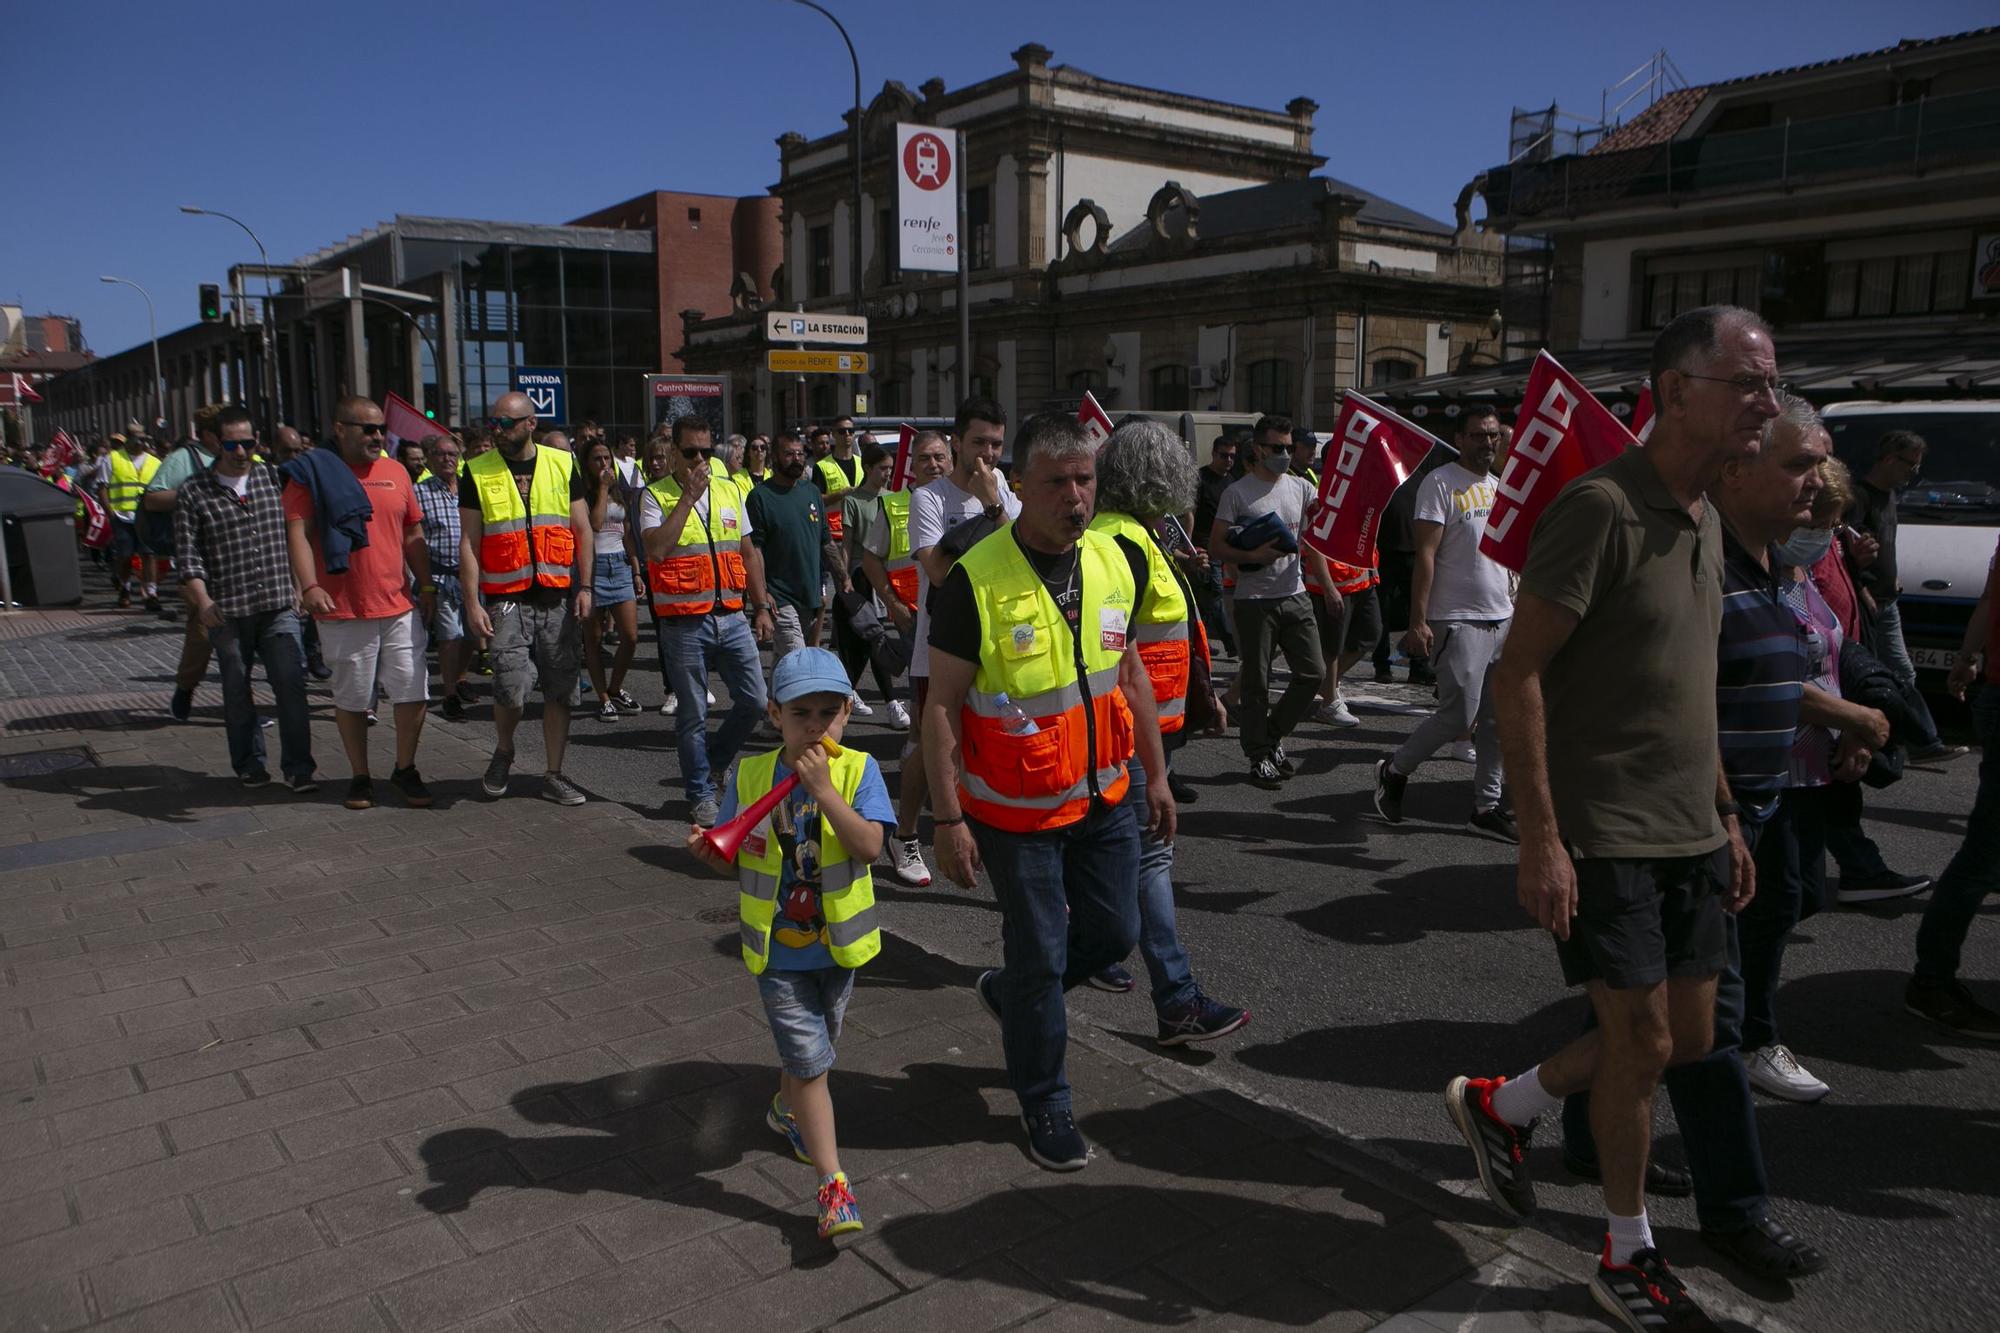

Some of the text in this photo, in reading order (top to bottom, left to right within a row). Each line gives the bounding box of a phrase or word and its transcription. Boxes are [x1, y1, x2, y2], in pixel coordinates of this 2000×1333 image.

[904, 216, 941, 233] renfe
[808, 323, 820, 334] LA
[823, 323, 865, 337] ESTACIÓN
[808, 357, 832, 366] RENFE
[519, 375, 561, 385] ENTRADA
[657, 383, 687, 394] Centro
[1484, 378, 1580, 544] CCOO
[1314, 409, 1381, 541] CCOO
[1357, 507, 1375, 557] ASTURIAS
